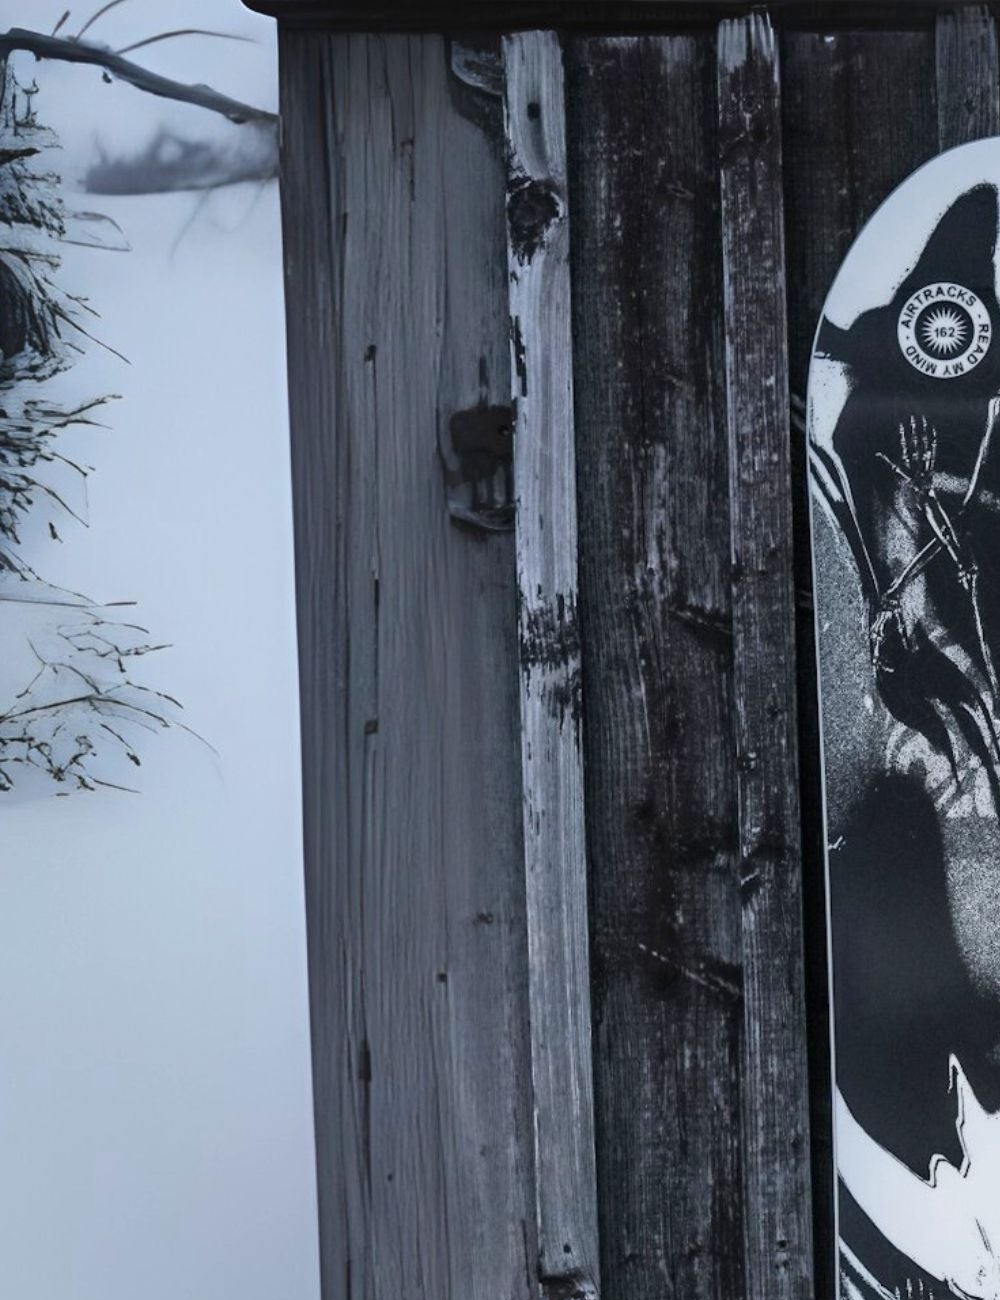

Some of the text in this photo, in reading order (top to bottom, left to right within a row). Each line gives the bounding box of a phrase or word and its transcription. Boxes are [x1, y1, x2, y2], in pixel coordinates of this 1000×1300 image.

[901, 286, 977, 329] AIRTRACKS
[906, 323, 989, 376] READ MY MIND
[934, 327, 956, 338] 162
